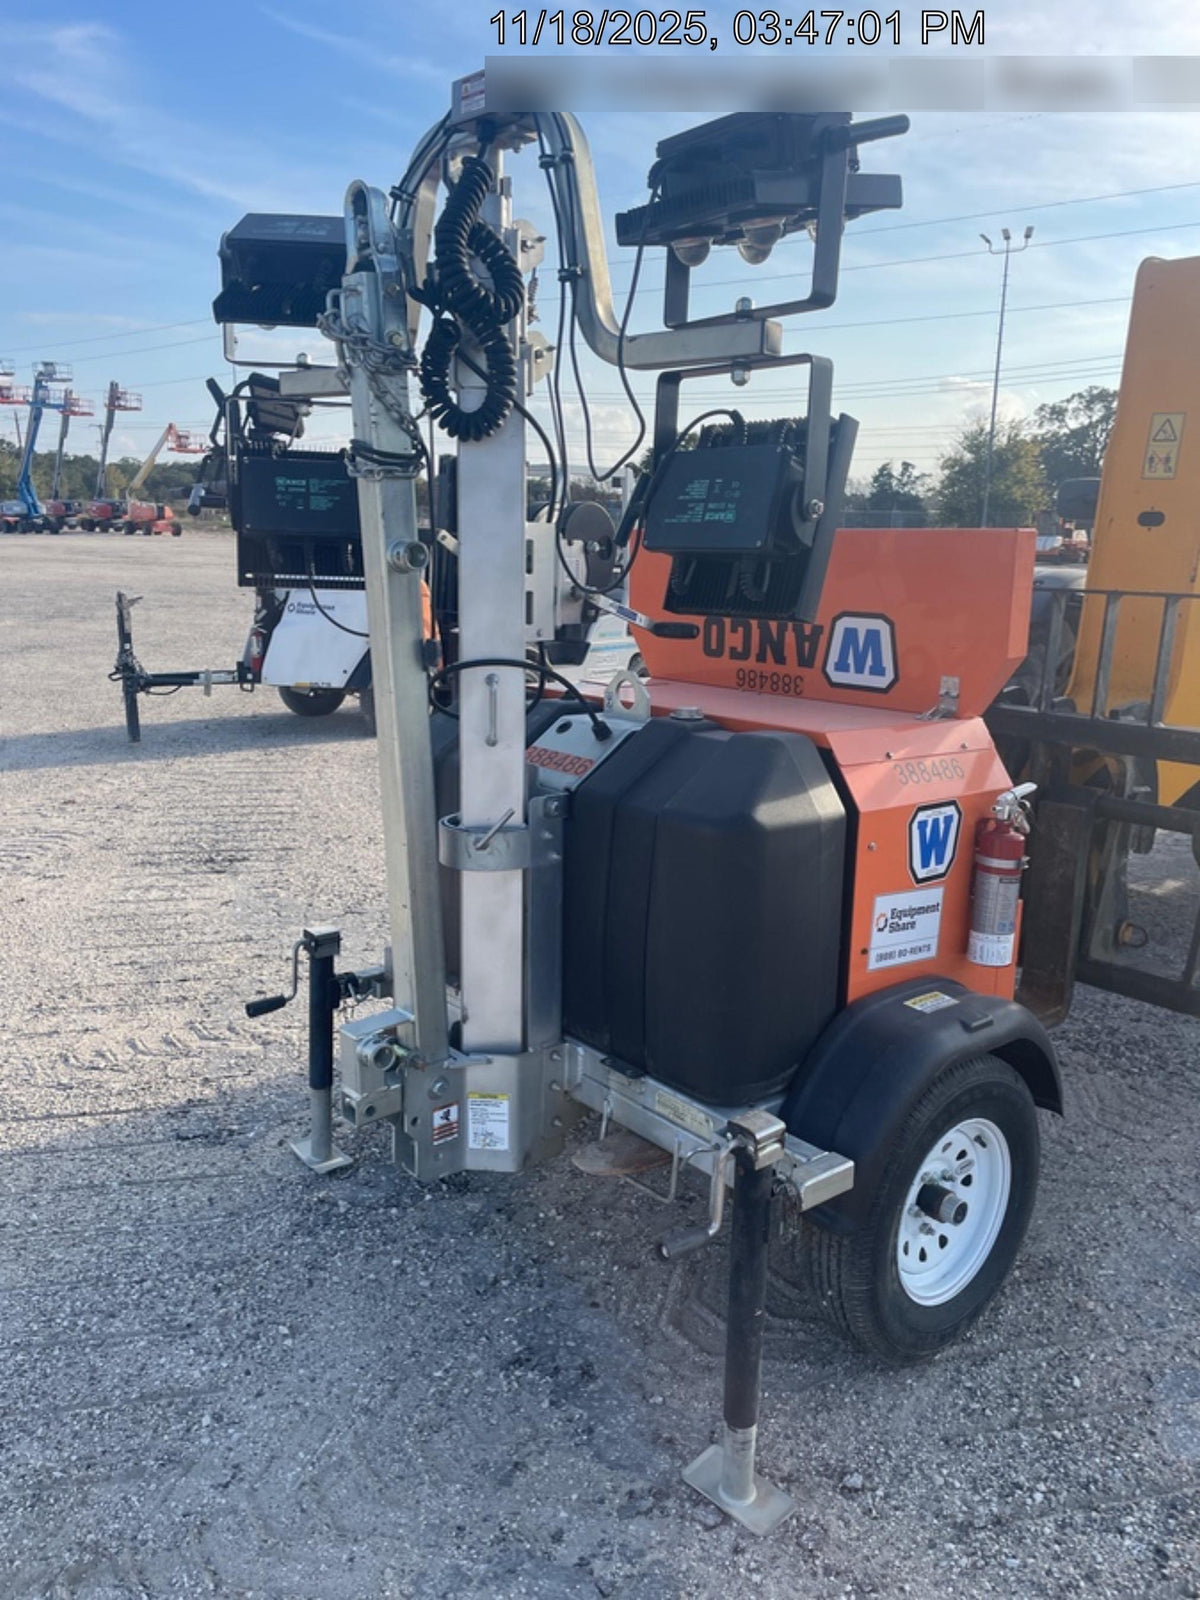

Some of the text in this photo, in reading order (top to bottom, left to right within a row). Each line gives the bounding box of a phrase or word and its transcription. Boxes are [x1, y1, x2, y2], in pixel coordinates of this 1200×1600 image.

[736, 667, 804, 696] 388486
[894, 758, 965, 785] 388486
[917, 814, 954, 870] W
[890, 902, 940, 921] Equipment
[888, 920, 917, 934] Share
